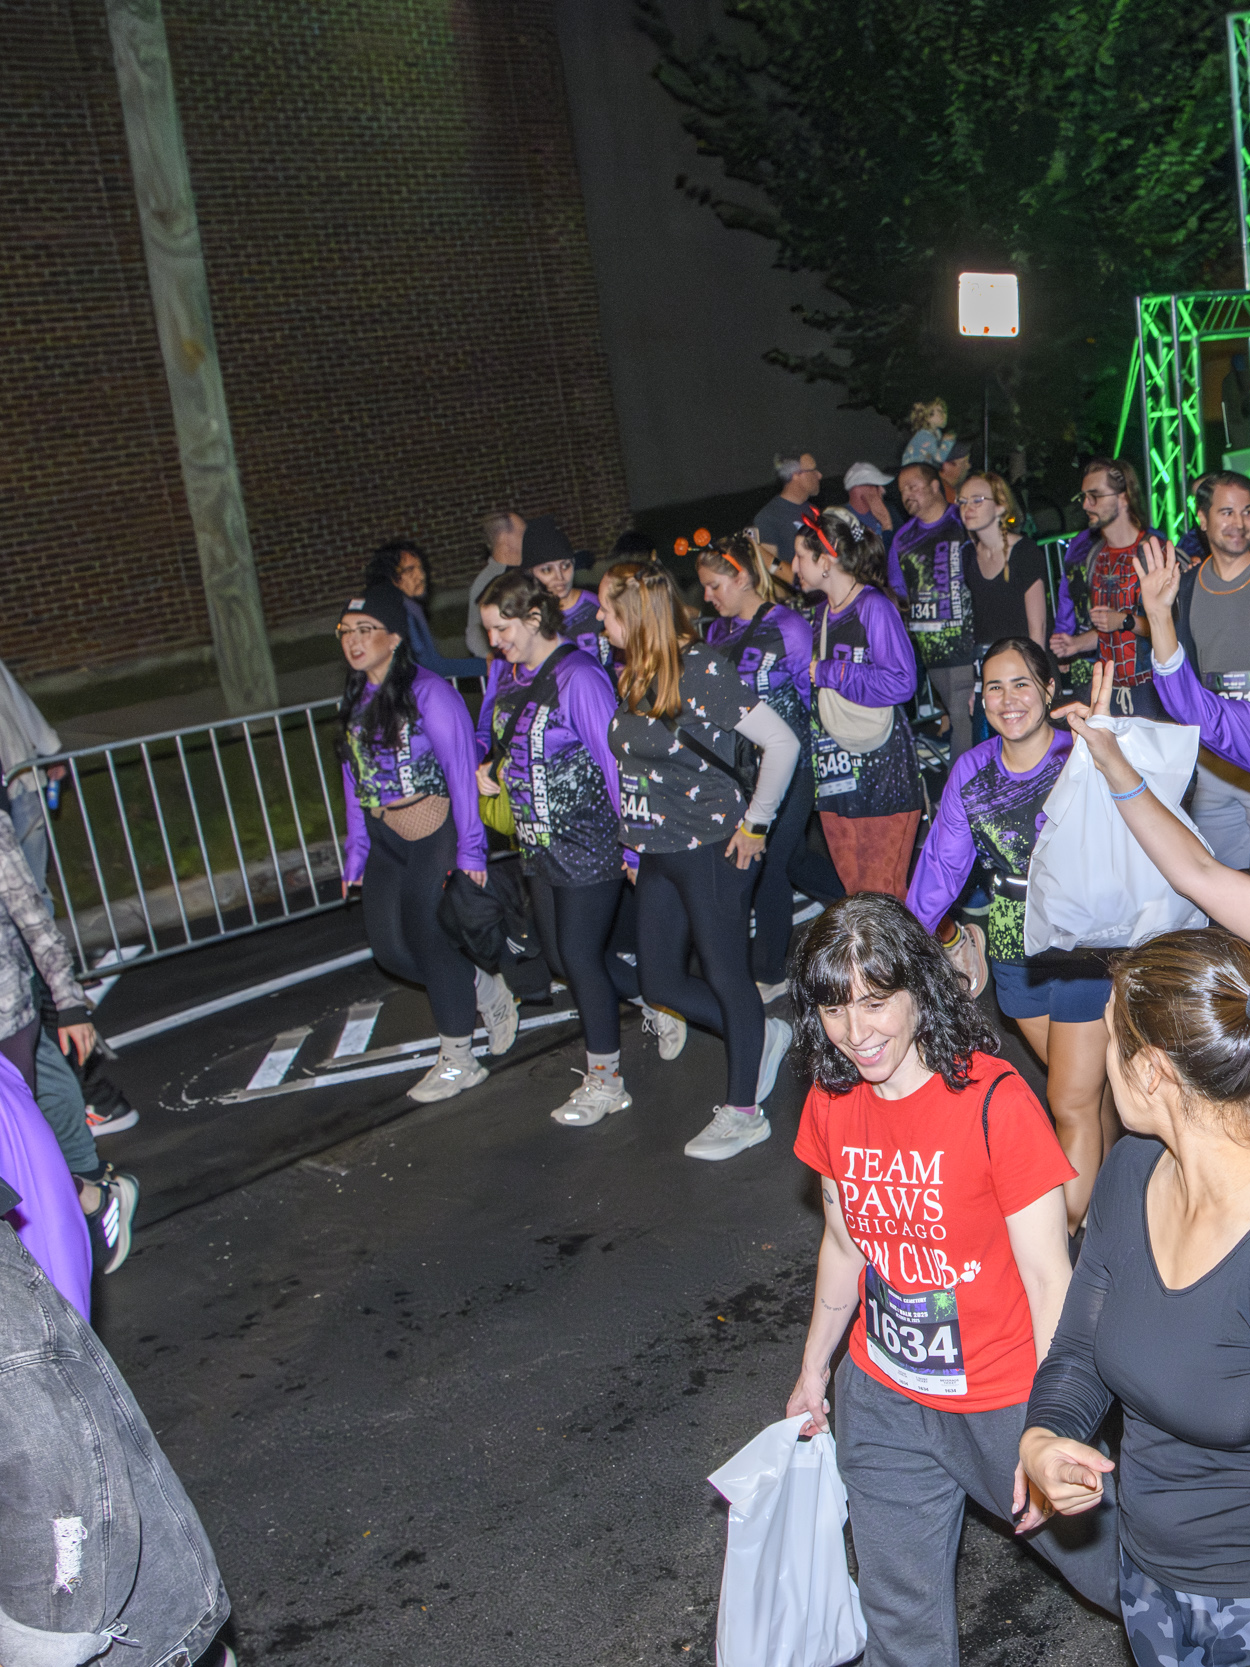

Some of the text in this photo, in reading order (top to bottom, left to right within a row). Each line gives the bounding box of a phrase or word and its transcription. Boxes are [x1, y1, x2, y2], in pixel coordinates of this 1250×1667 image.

[515, 820, 537, 846] 45
[841, 1146, 944, 1184] TEAM
[841, 1180, 944, 1222] PAWS
[845, 1213, 947, 1240] CHICAGO
[852, 1237, 958, 1289] AN CLUB
[868, 1298, 958, 1364] 1634
